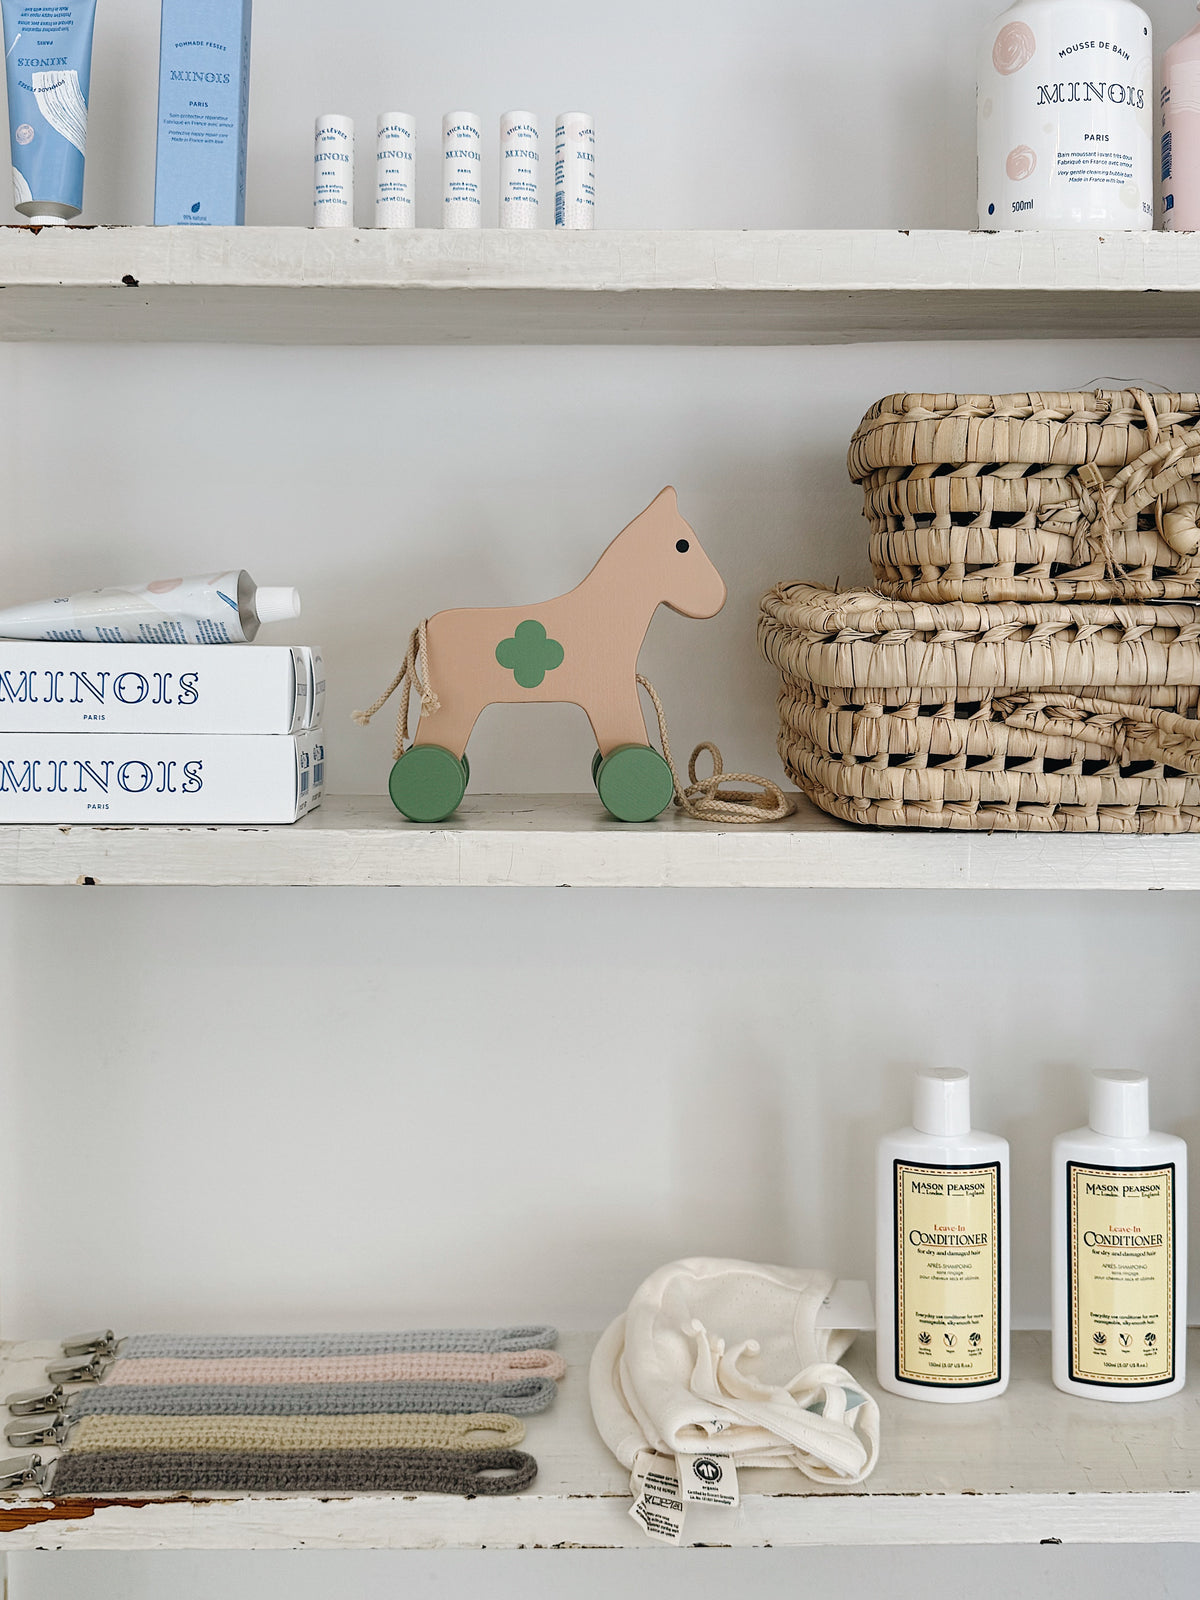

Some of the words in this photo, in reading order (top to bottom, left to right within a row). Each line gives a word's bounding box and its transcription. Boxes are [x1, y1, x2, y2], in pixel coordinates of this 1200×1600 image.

[206, 42, 227, 51] FESSES
[1059, 41, 1095, 58] MOUSSE
[1098, 41, 1110, 49] DE
[1112, 45, 1130, 60] BAIN
[18, 56, 68, 66] MINOIS
[170, 70, 230, 84] MINOIS
[1037, 82, 1144, 109] MINOIS
[1011, 199, 1034, 213] 500ml
[0, 670, 199, 705] MINOIS
[0, 760, 203, 793] MINOIS
[912, 1181, 944, 1194] MASON
[947, 1183, 985, 1196] PEARSON
[1086, 1182, 1119, 1195] MASON
[1123, 1184, 1160, 1197] PEARSON
[909, 1230, 988, 1246] CONDITIONER
[1083, 1231, 1163, 1247] CONDITIONER
